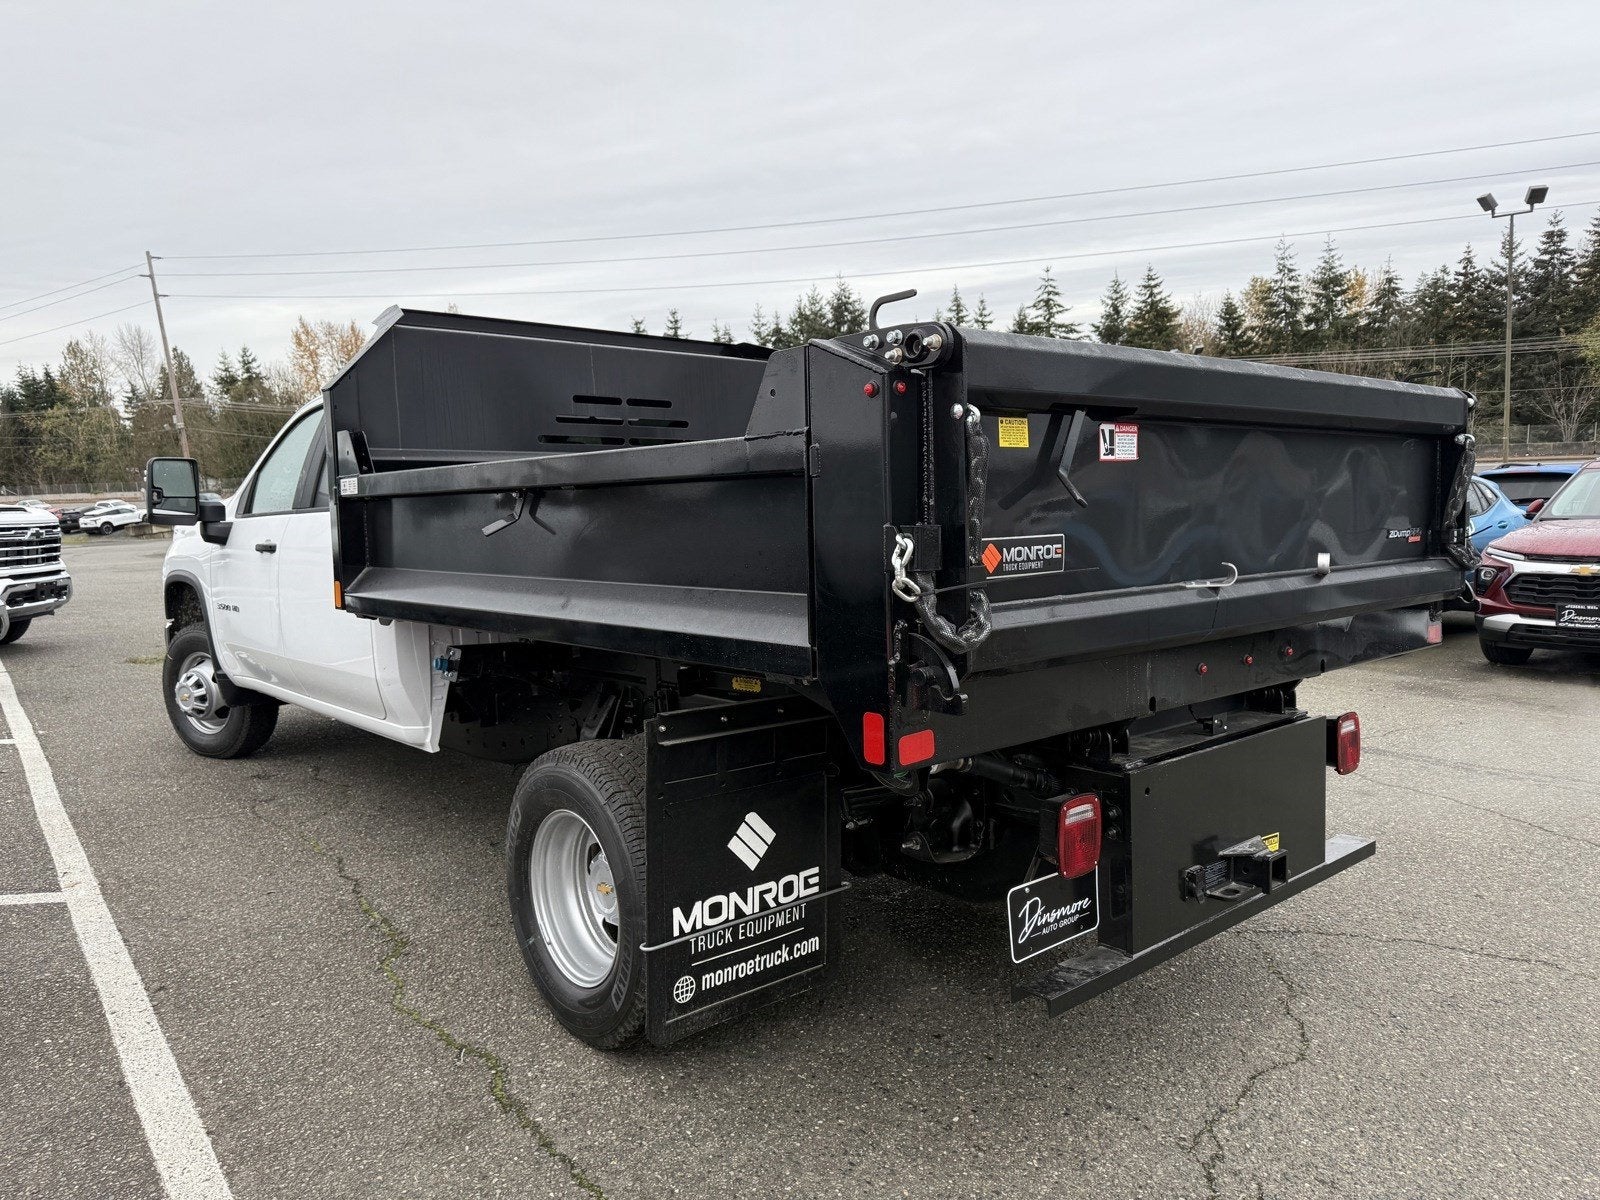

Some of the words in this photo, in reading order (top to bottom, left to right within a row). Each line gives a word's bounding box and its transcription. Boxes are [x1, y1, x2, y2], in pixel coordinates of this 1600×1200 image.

[1002, 544, 1062, 563] MONROE
[1002, 562, 1018, 572] TRUCK
[1018, 560, 1044, 571] EQUIPMENT
[672, 866, 820, 938] MONROE
[1018, 896, 1092, 944] Dinsmore
[1041, 922, 1058, 936] AUTO
[1058, 913, 1080, 929] GROUP
[689, 926, 733, 955] TRUCK
[738, 902, 807, 940] EQUIPMENT
[701, 936, 820, 991] monroetruck.com
